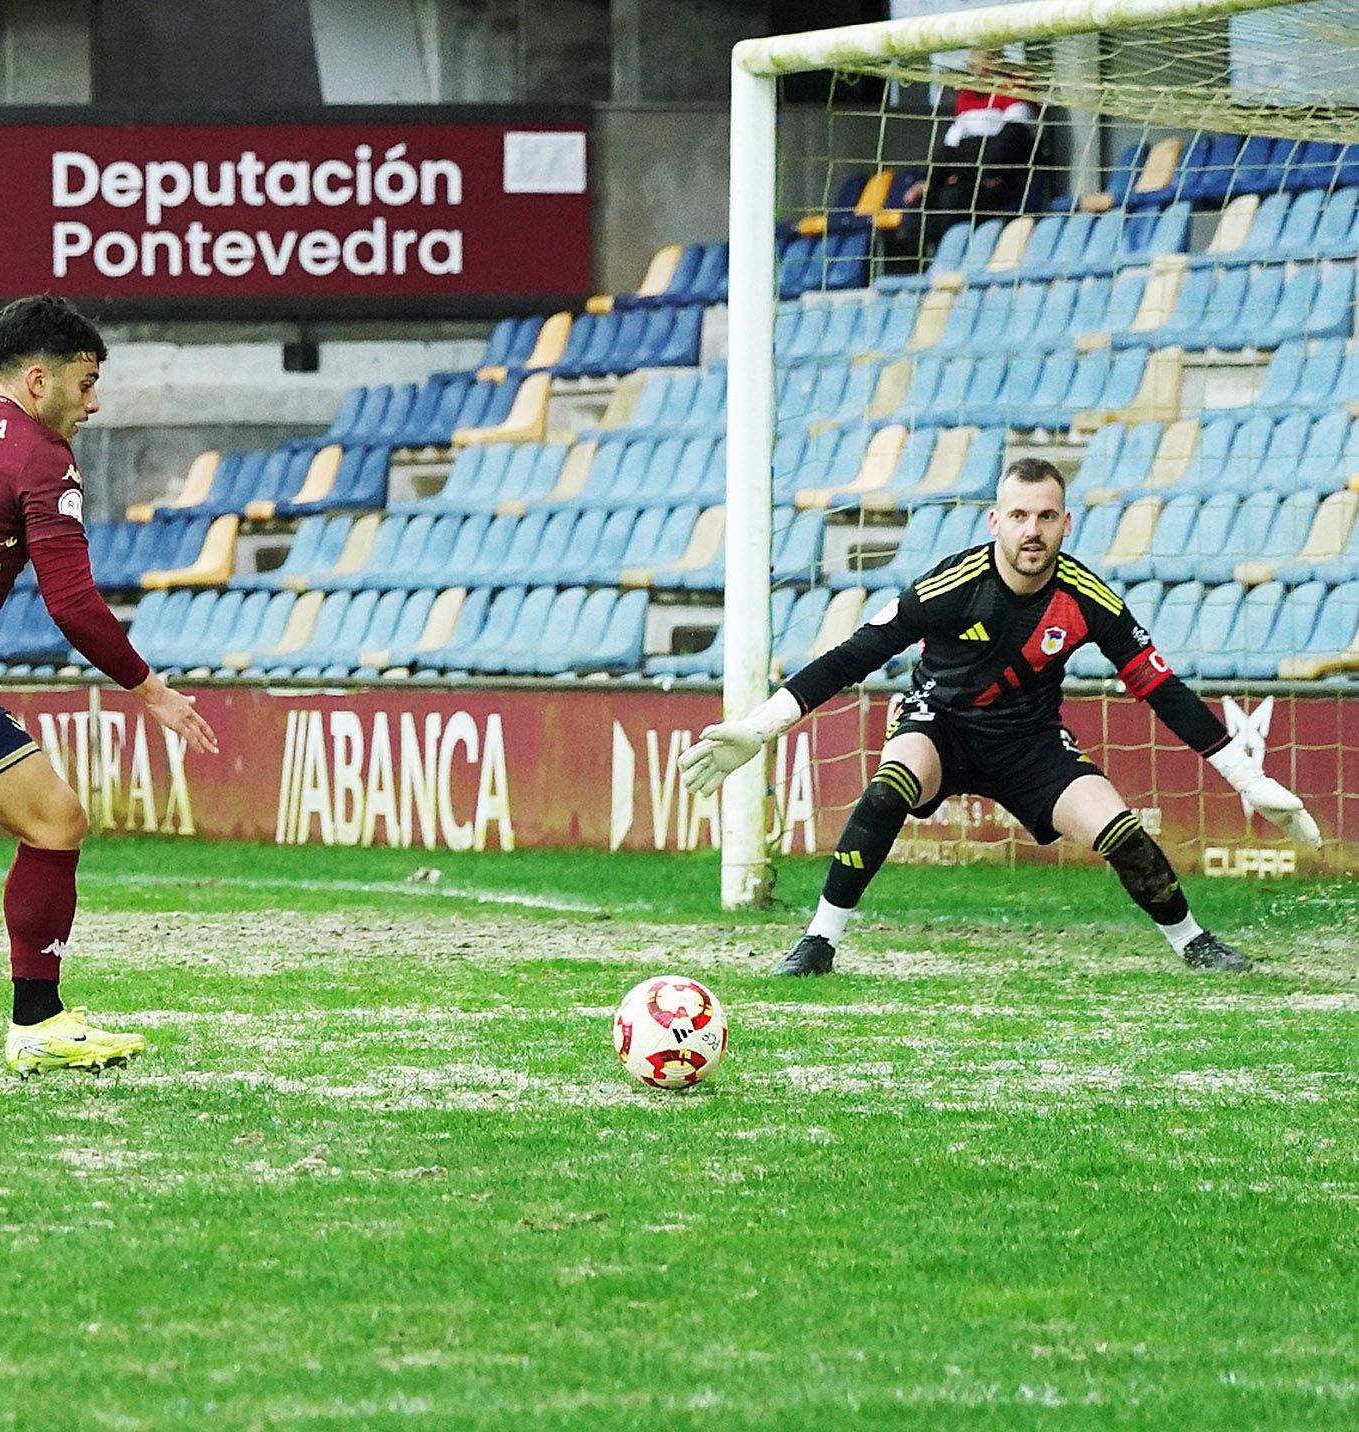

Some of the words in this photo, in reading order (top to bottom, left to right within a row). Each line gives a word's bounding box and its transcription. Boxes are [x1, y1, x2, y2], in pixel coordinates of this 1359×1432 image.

[52, 143, 463, 226] Deputación
[52, 216, 464, 278] Pontevedra
[275, 709, 515, 852] ABANCA
[1204, 848, 1296, 879] CUPRA
